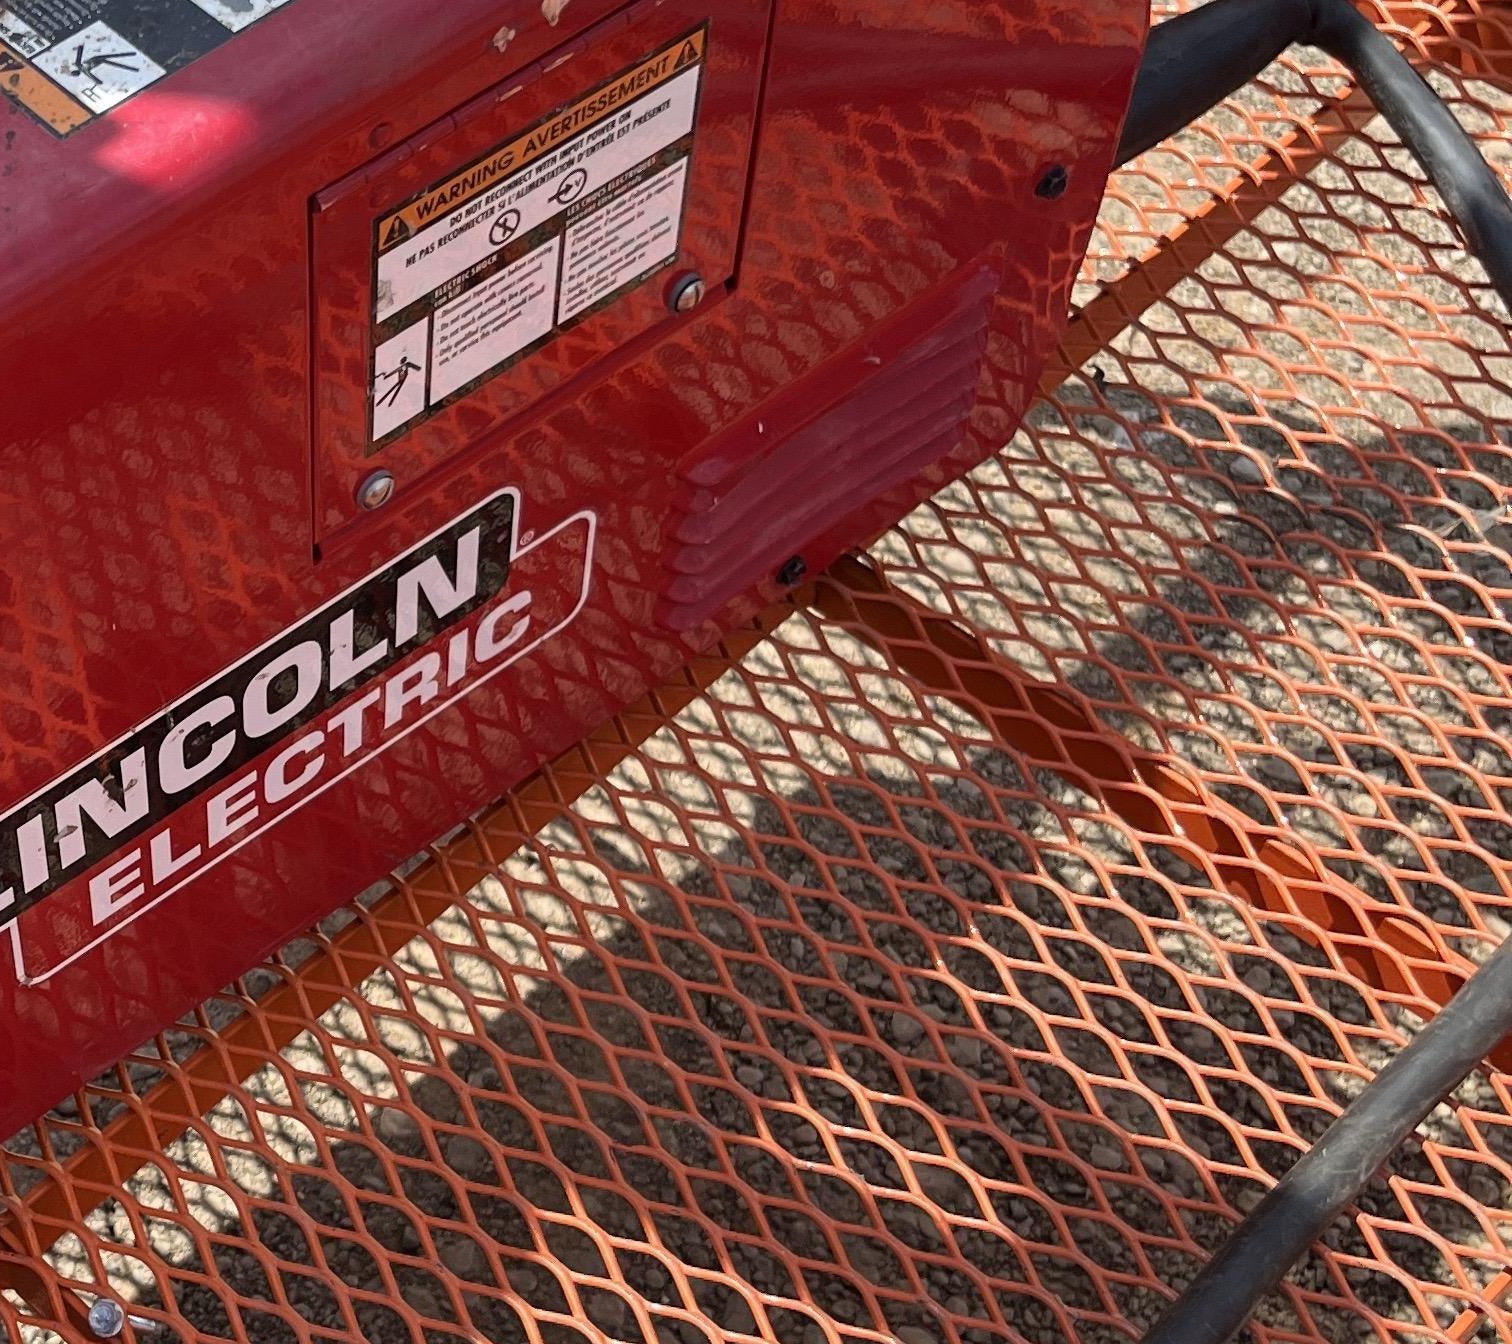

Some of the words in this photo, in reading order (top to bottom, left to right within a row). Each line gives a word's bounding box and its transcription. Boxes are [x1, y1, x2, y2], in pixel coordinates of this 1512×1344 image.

[416, 152, 514, 219] WARNING
[523, 55, 670, 157] AVERTISSEMENT
[450, 213, 462, 227] DO
[465, 200, 482, 218] NOT
[485, 170, 533, 206] RECONNECT
[587, 119, 616, 144] POWER
[619, 110, 631, 124] ON
[88, 590, 532, 927] ELECTRIC
